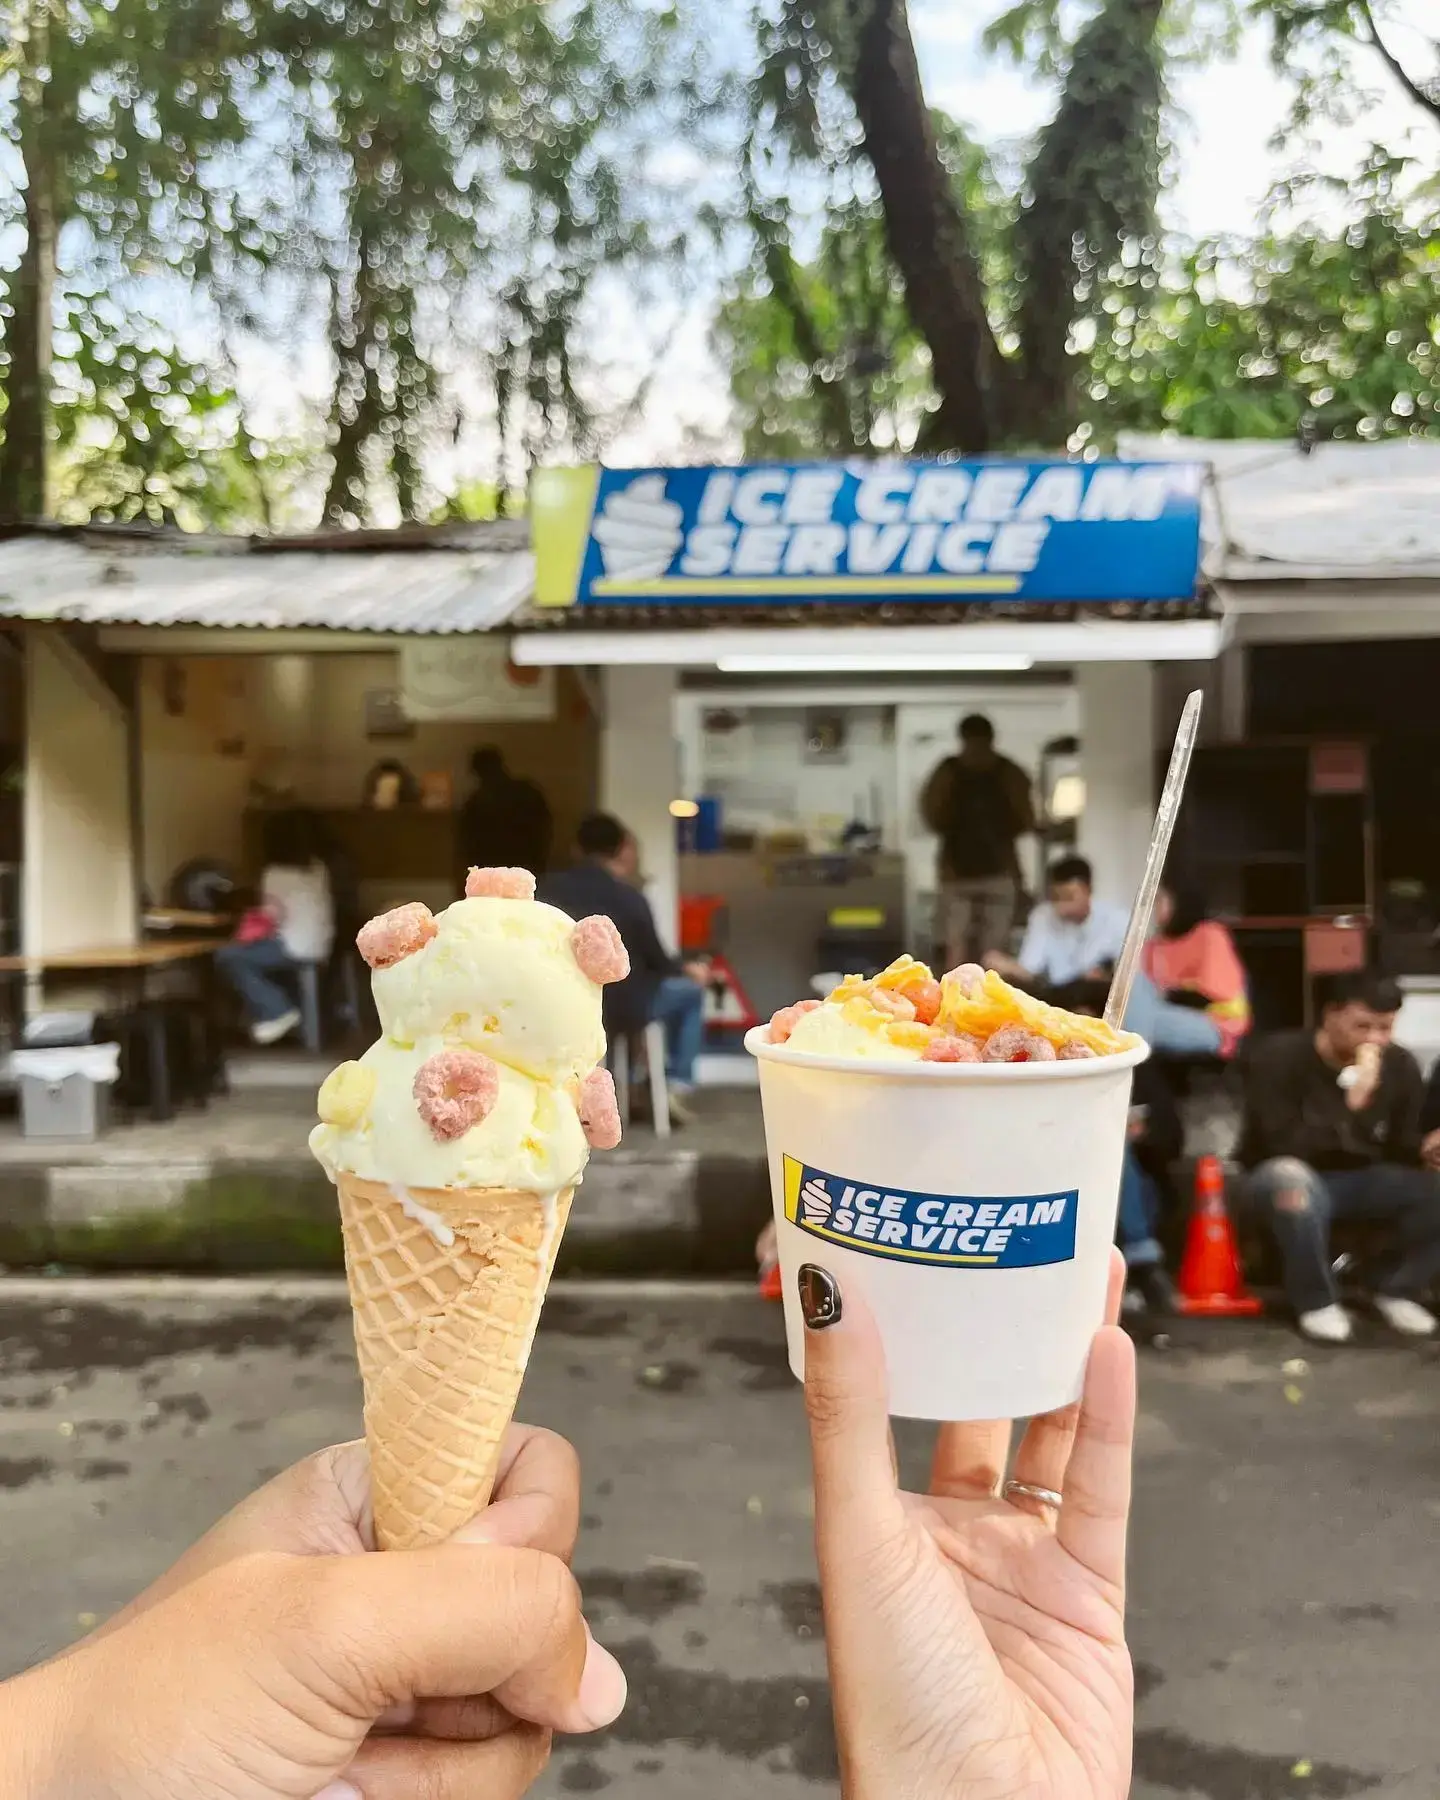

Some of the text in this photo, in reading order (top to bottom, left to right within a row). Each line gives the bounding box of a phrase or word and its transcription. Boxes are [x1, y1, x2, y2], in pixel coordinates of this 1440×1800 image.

[700, 467, 1168, 523] ICE CREAM
[682, 522, 1048, 574] SERVICE
[840, 1186, 1067, 1227] ICE CREAM
[833, 1209, 1012, 1252] SERVICE
